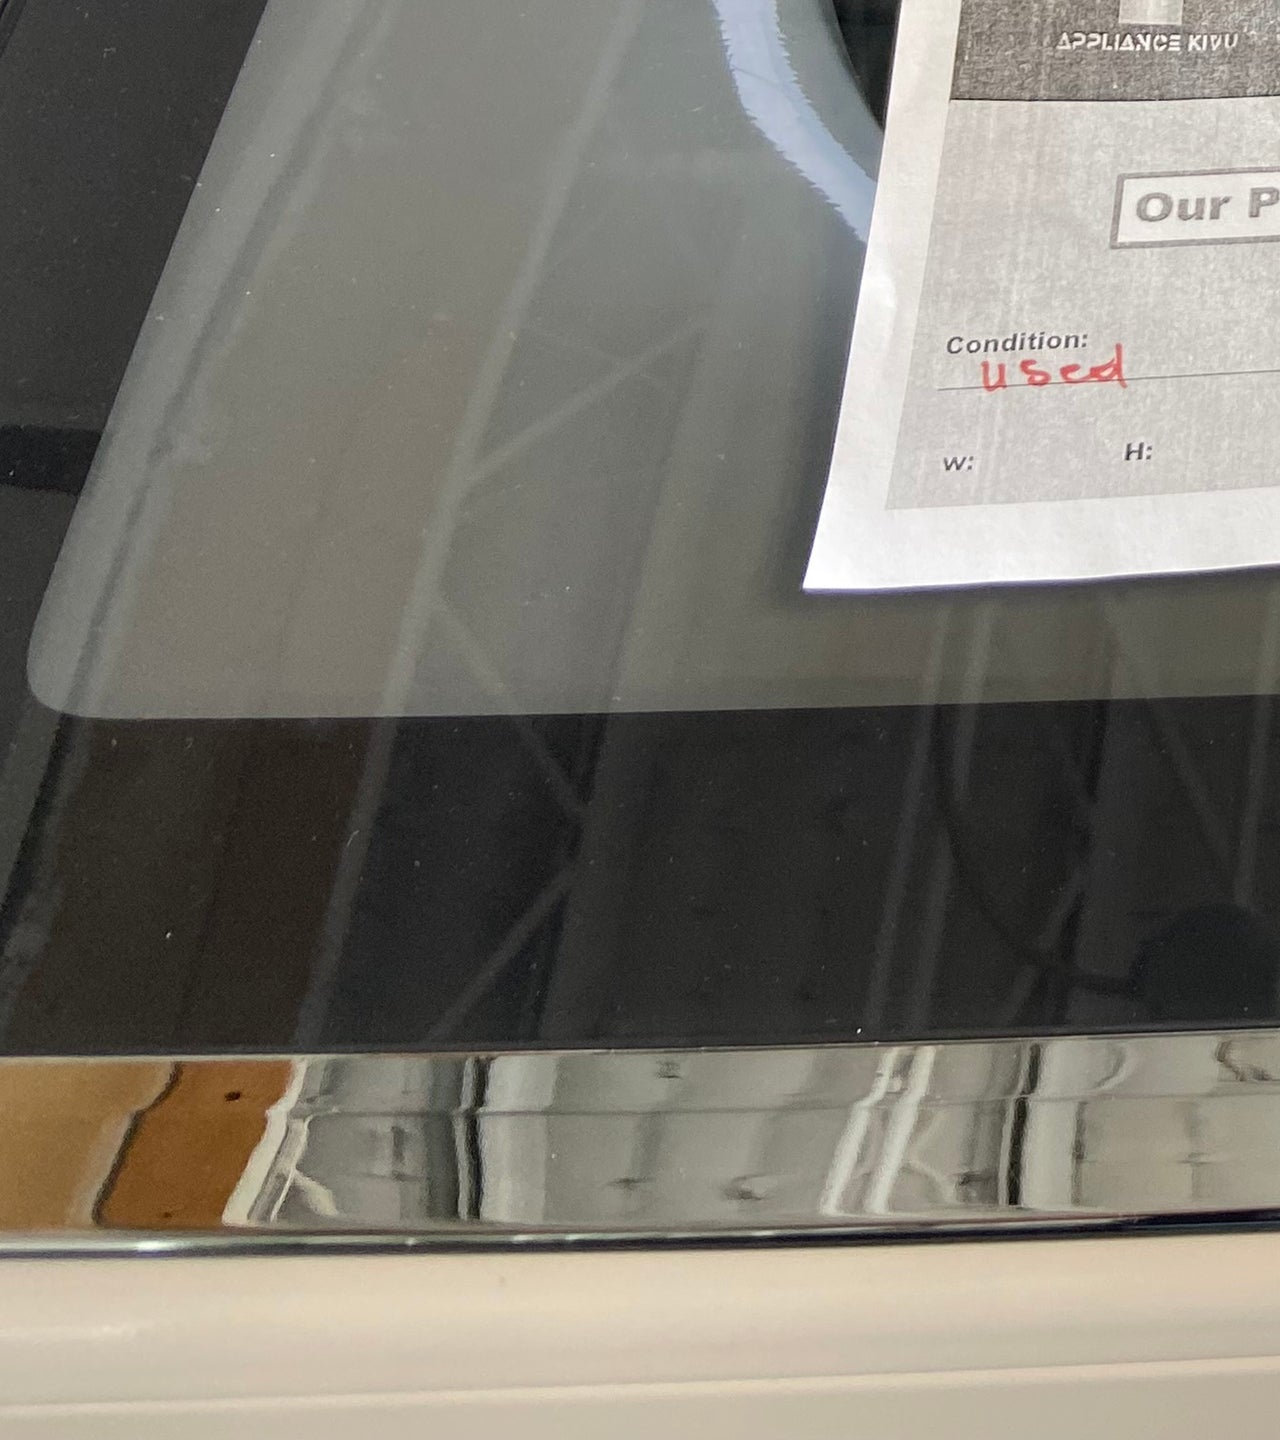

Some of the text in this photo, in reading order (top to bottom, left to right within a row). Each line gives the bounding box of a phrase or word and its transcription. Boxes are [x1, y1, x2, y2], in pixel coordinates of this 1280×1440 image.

[1056, 31, 1240, 53] APPLIANCE KIVU
[1135, 188, 1232, 223] Our
[945, 331, 1089, 355] Condition:
[1124, 441, 1153, 462] H:
